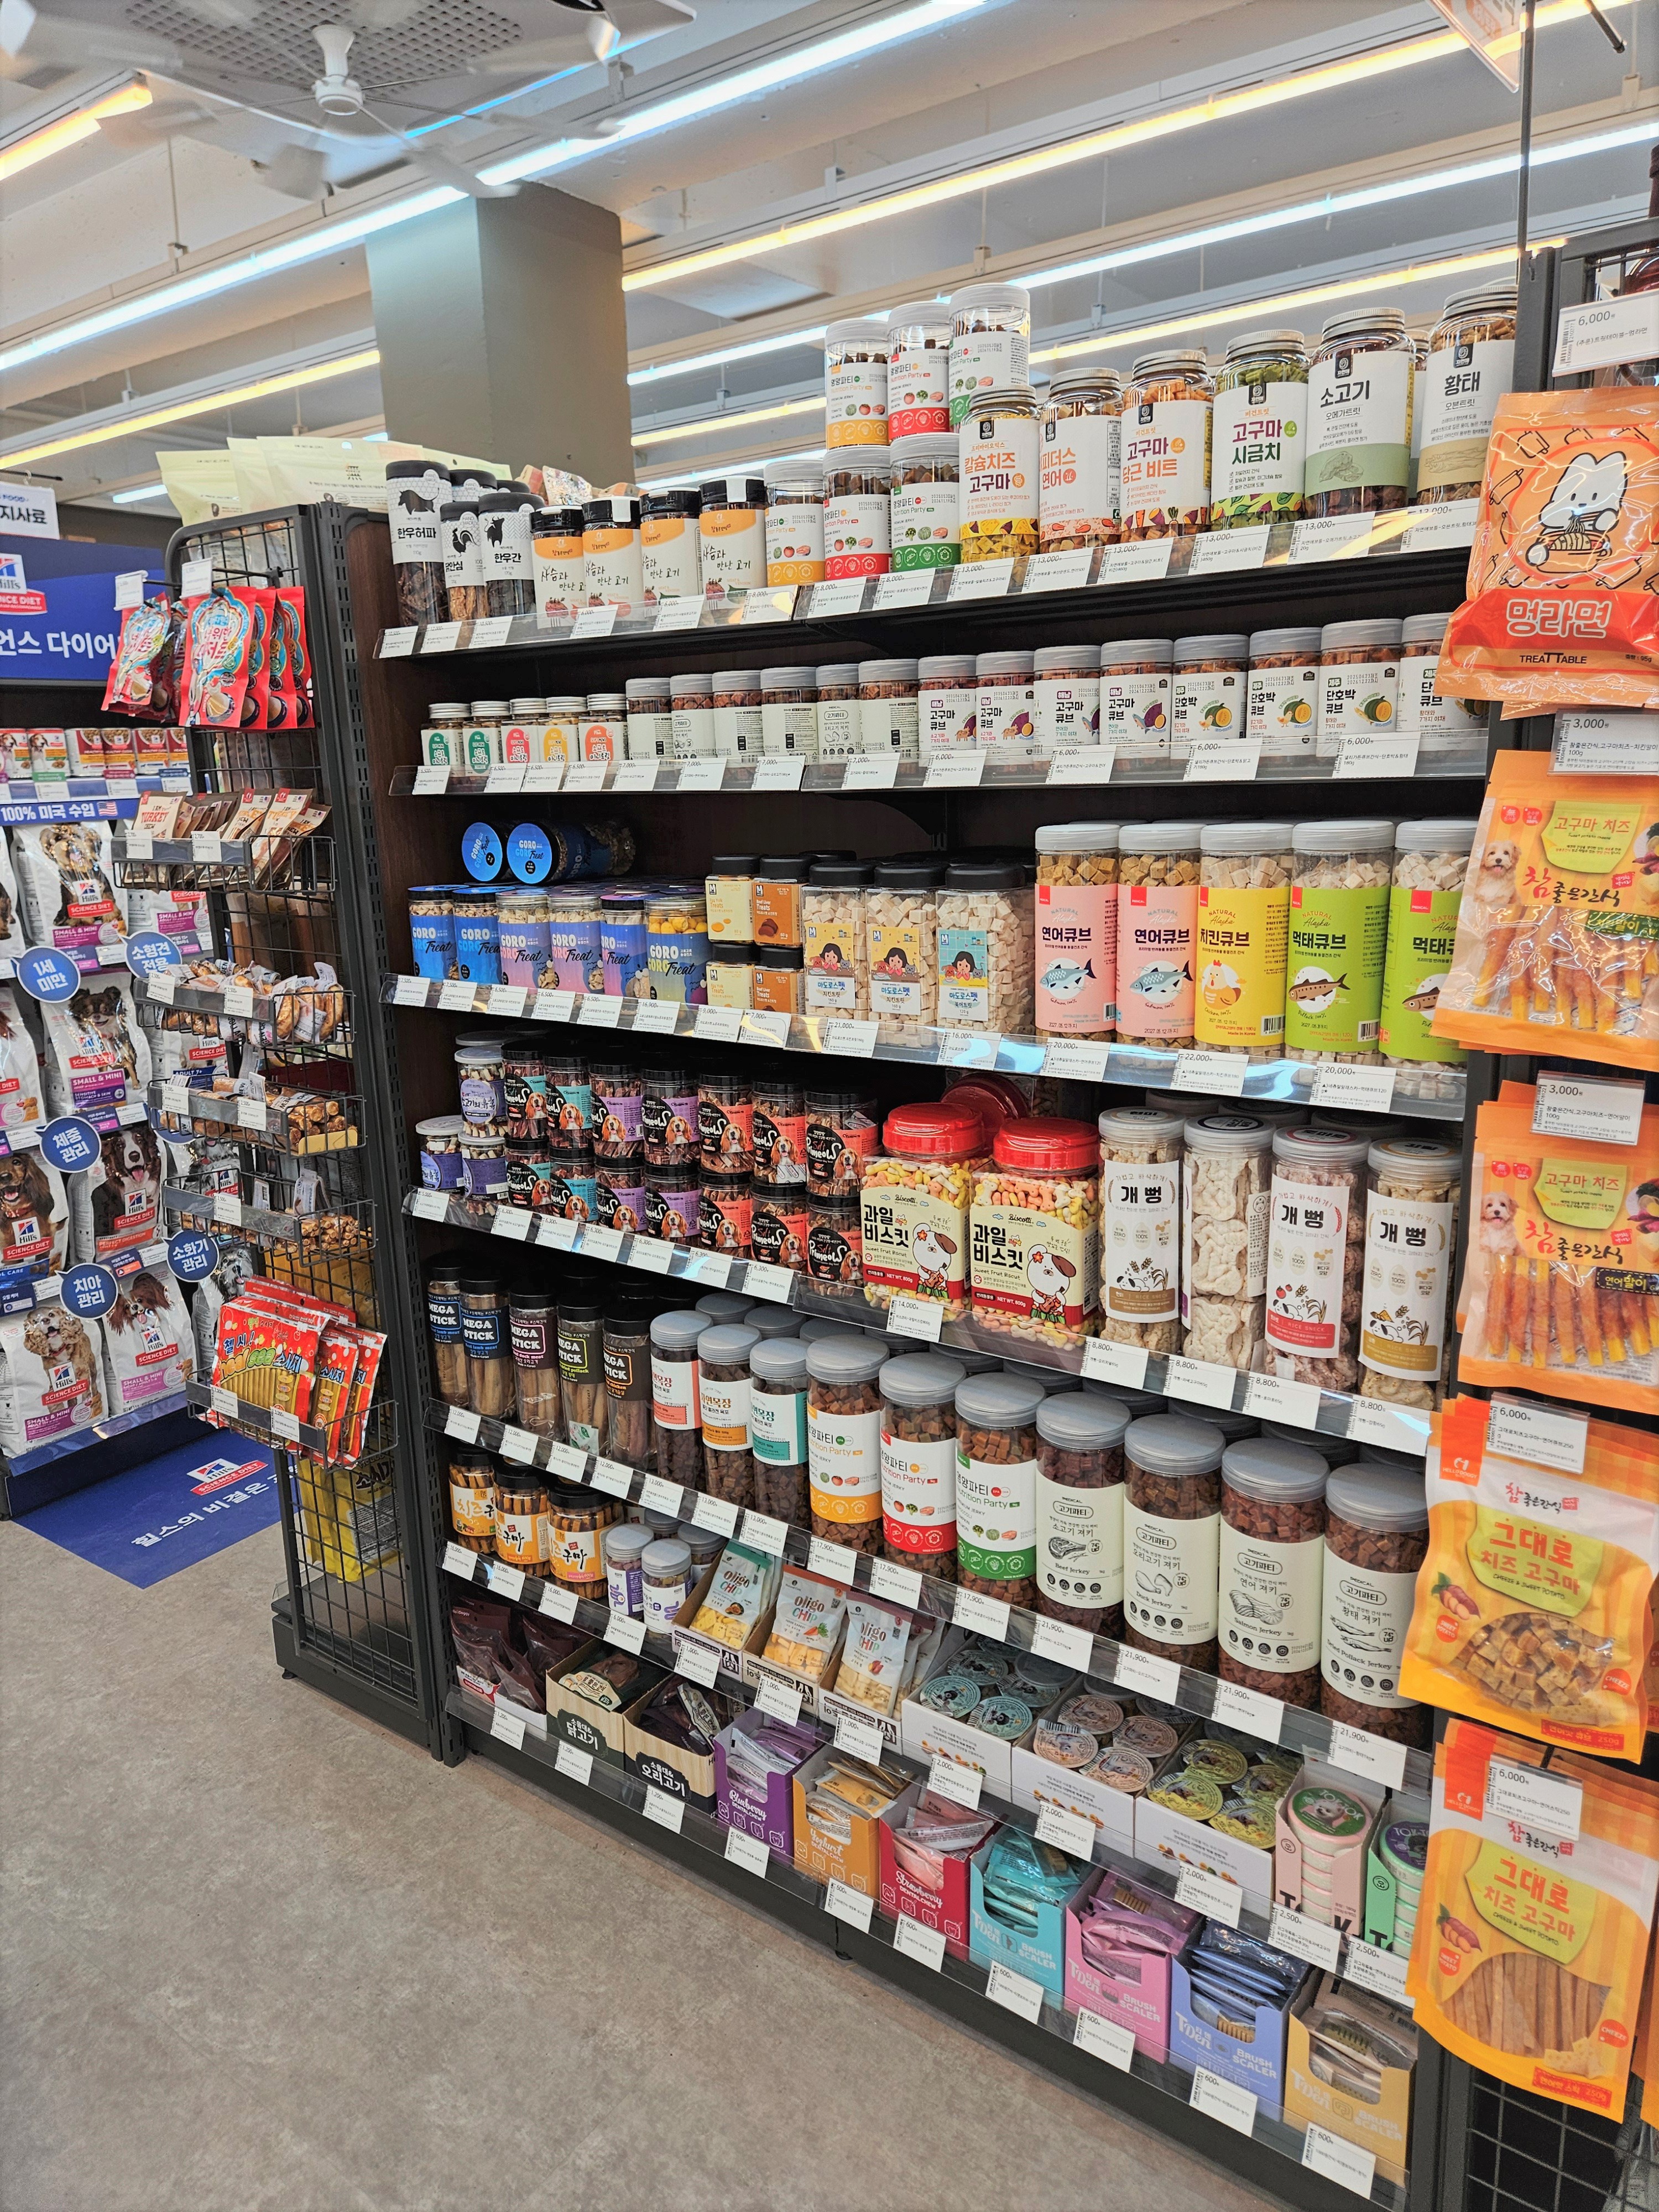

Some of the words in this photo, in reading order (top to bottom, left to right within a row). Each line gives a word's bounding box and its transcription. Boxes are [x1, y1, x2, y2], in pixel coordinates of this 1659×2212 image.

[1444, 371, 1480, 397] 황태
[1321, 380, 1370, 408] 소고기
[1245, 408, 1269, 416] 비건트릿
[1326, 406, 1360, 420] 오메가트릿
[1445, 398, 1475, 411] 오븐트릿
[1232, 420, 1282, 442] 고구마
[1127, 438, 1168, 460] 고구마
[1232, 444, 1281, 465] 시금치
[964, 452, 1016, 474] 칼슘치즈
[1123, 463, 1145, 484] 당근
[1149, 459, 1177, 476] 비트
[969, 473, 1011, 493] 고구마
[1042, 469, 1062, 490] 연어
[893, 497, 914, 509] 영양파티
[397, 526, 437, 540] 한우허파
[494, 552, 521, 564] 한우간
[717, 560, 734, 570] 만난
[734, 559, 751, 570] 고기
[597, 576, 613, 587] 만난
[614, 575, 629, 586] 고기
[1506, 599, 1612, 638] 멍라면
[46, 632, 122, 660] 다이어
[1520, 652, 1587, 664] TREATTABLE
[1327, 689, 1356, 701] 단호박
[1056, 700, 1083, 713] 고구마
[1326, 703, 1343, 714] 큐브
[1056, 712, 1074, 723] 큐브
[1, 806, 36, 820] 100%
[40, 804, 65, 818] 미국
[69, 802, 95, 817] 수입
[1554, 817, 1597, 832] 고구마
[1603, 820, 1630, 833] 치즈
[519, 840, 536, 849] GORO
[1208, 909, 1236, 919] NATURAL
[1302, 911, 1332, 920] NATURAL
[501, 933, 526, 947] GORO
[1042, 927, 1092, 942] 연어큐브
[1134, 928, 1190, 944] 연어큐브
[1200, 928, 1250, 947] 치킨큐브
[1292, 931, 1347, 950] 먹태큐브
[131, 942, 172, 960] 소형견
[515, 950, 543, 964] Treat
[650, 944, 679, 959] GORO
[33, 958, 56, 977] 1세
[665, 961, 696, 977] Treat
[36, 973, 69, 992] 미만
[818, 981, 845, 990] 마도로스펫
[73, 1077, 97, 1087] SMALL
[104, 1072, 122, 1081] MINI
[53, 1127, 82, 1149] 체중
[60, 1142, 90, 1164] 관리
[1545, 1172, 1587, 1187] 고구마
[1593, 1175, 1619, 1191] 치즈
[895, 1194, 916, 1203] Biscotti
[1121, 1185, 1138, 1204] 개
[1145, 1185, 1162, 1204] 뻥
[864, 1204, 893, 1225] 과일
[19, 1234, 37, 1244] Hill's
[864, 1224, 909, 1248] 비스킷
[974, 1224, 1006, 1246] 과일
[1381, 1220, 1399, 1240] 개
[1406, 1227, 1427, 1246] 뻥
[7, 1245, 34, 1256] SCIENCE
[35, 1240, 50, 1249] DIET
[172, 1238, 207, 1260] 소화기
[1557, 1238, 1624, 1265] 좋은간식
[182, 1253, 211, 1272] 관리
[974, 1245, 1023, 1271] 비스킷
[73, 1275, 101, 1293] 치아
[1604, 1275, 1647, 1289] 연어말이
[77, 1290, 105, 1309] 관리
[463, 1317, 492, 1329] MEGA
[511, 1326, 539, 1338] MEGA
[464, 1329, 494, 1341] STICK
[512, 1338, 541, 1350] STICK
[247, 1348, 276, 1369] sea
[273, 1352, 303, 1374] 소시지
[131, 1512, 205, 1547] 힐스의
[202, 1482, 269, 1514] 비결은
[1059, 1505, 1087, 1516] 고기파티
[1053, 1524, 1074, 1536] 소고기
[1490, 1520, 1574, 1569] 그대로
[1055, 1563, 1068, 1572] Beef
[1480, 1550, 1517, 1575] 치즈
[1524, 1562, 1580, 1596] 고구마
[720, 1580, 742, 1595] CHIP
[724, 1570, 750, 1588] oligo
[1493, 1574, 1515, 1585] CHEEZE
[1521, 1582, 1541, 1593] SWEET
[1541, 1587, 1566, 1600] POTATO
[1346, 1584, 1379, 1602] 고기파티
[794, 1594, 825, 1613] oligo
[792, 1607, 817, 1624] CHIP
[1342, 1606, 1359, 1621] 황태
[1327, 1639, 1340, 1653] Dried
[1341, 1650, 1366, 1665] Pollack
[1368, 1659, 1392, 1671] Jerky
[1606, 1674, 1630, 1691] CHEEZE
[567, 1721, 598, 1750] 닭고기
[641, 1764, 685, 1797] 오리고기
[729, 1790, 767, 1820] Blueberry
[810, 1828, 844, 1856] Yoghurt
[896, 1870, 943, 1908] Strawberry
[1494, 1856, 1571, 1914] 그대로
[1483, 1886, 1516, 1915] 치즈
[1521, 1904, 1576, 1943] 고구마
[1019, 1950, 1056, 1971] SCALER
[1021, 1942, 1053, 1960] BRUSH
[1120, 2001, 1161, 2023] SCALER
[1124, 1994, 1157, 2013] BRUSH
[1233, 2056, 1277, 2080] SCALER
[1237, 2048, 1273, 2069] BRUSH
